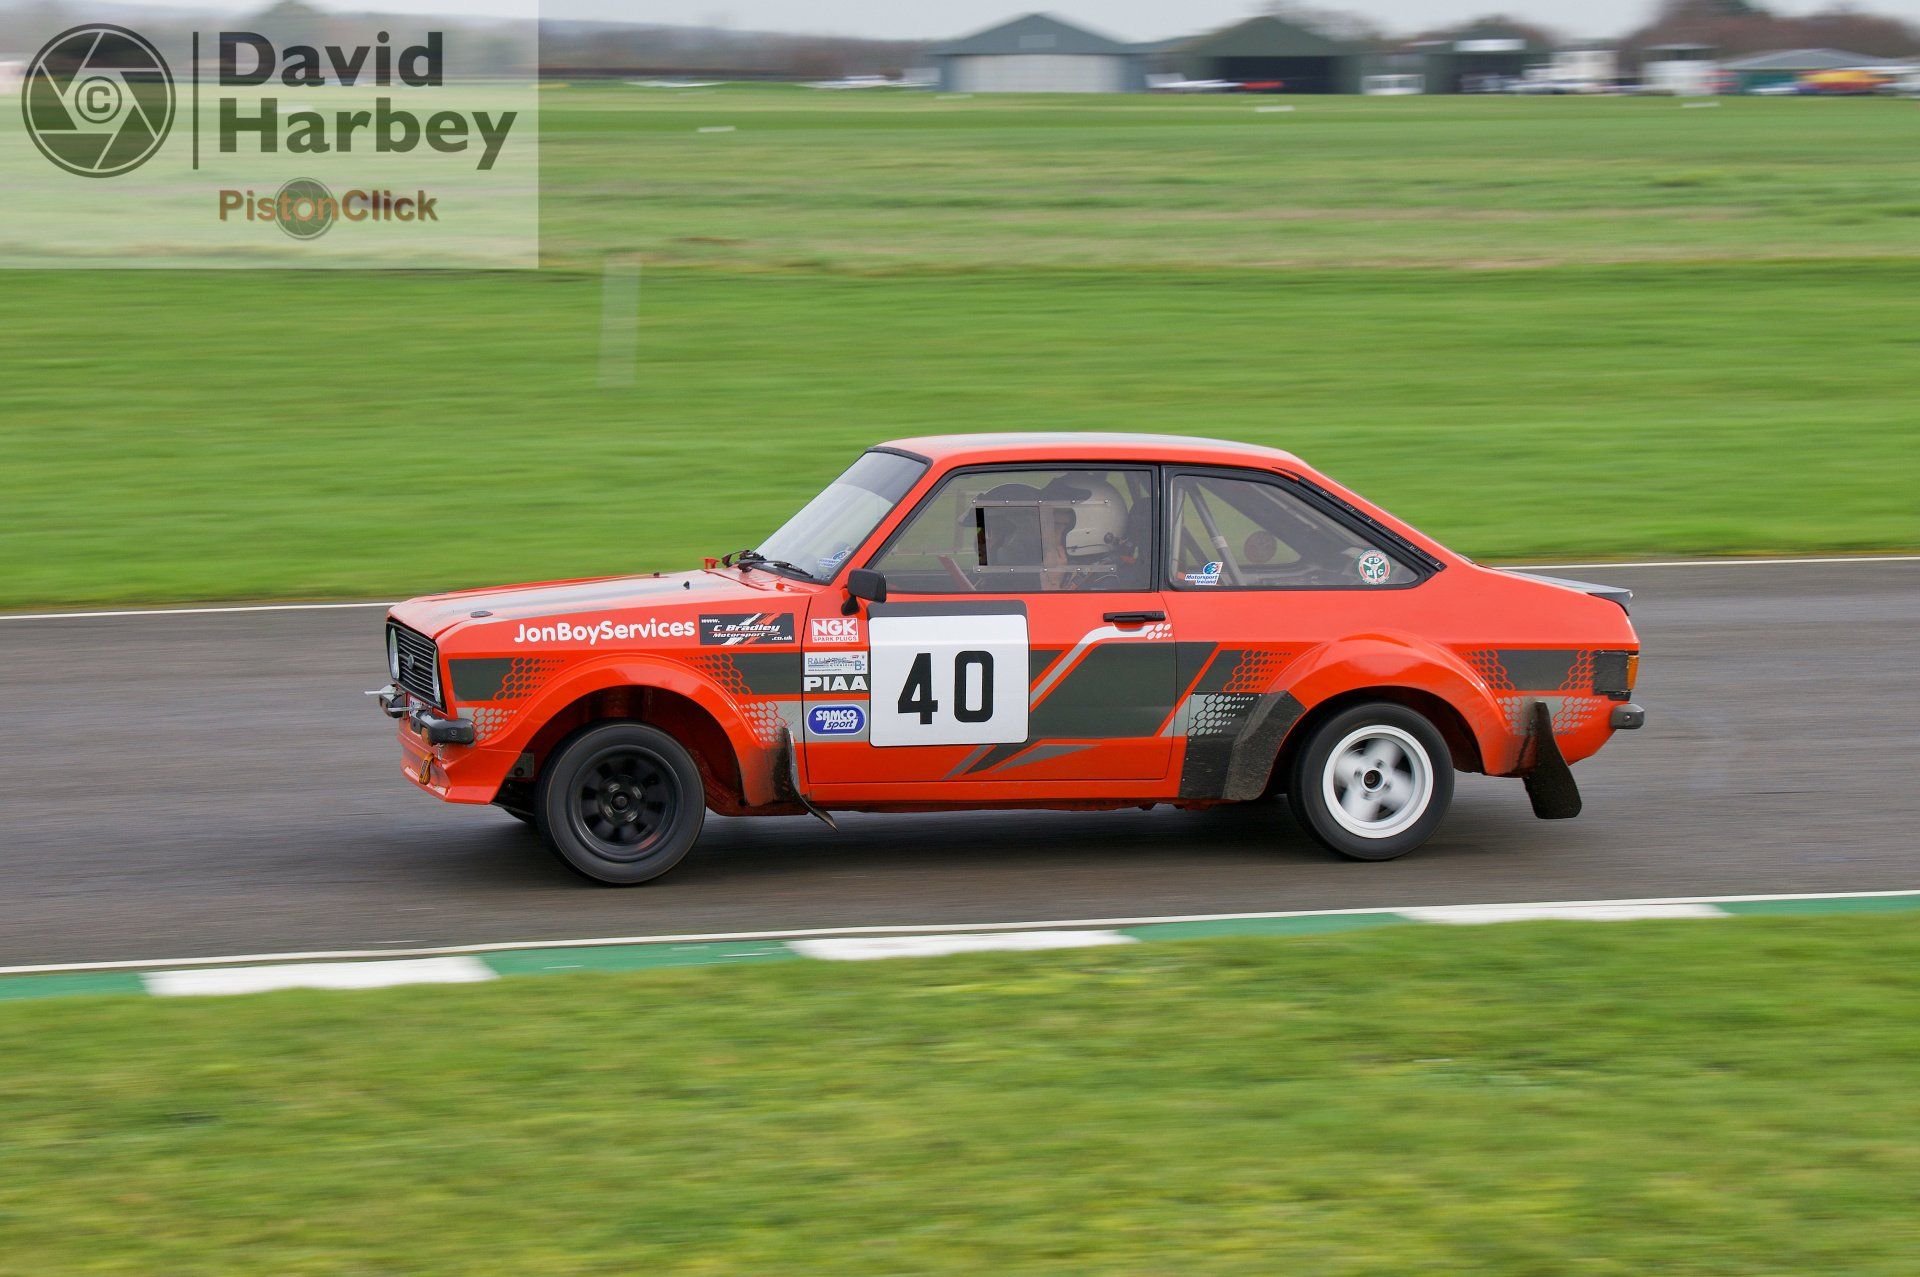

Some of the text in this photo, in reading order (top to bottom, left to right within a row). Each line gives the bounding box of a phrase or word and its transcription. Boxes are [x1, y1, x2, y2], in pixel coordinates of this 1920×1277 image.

[514, 617, 695, 645] JonBoyServices
[813, 619, 856, 636] NGK
[804, 676, 868, 691] PIAA
[898, 650, 994, 724] 40
[816, 710, 856, 721] SAMCO
[828, 719, 853, 728] sport
